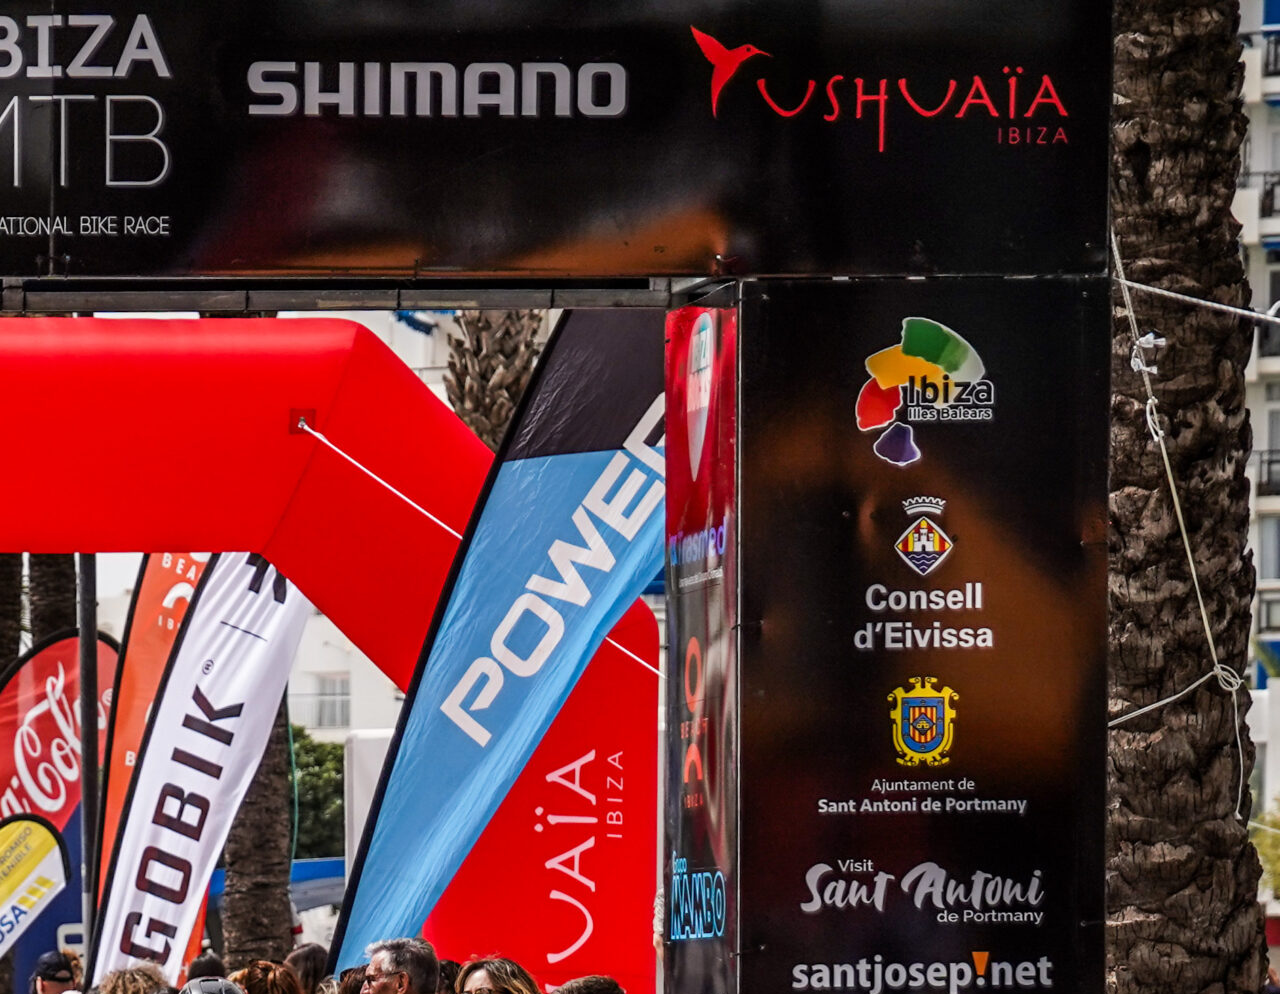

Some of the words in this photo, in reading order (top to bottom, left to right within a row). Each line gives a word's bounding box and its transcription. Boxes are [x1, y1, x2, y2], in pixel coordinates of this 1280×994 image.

[246, 61, 627, 117] SHIMANO
[755, 66, 1070, 154] USHUAÏA
[997, 126, 1069, 146] IBIZA
[79, 215, 118, 235] BIKE
[124, 215, 170, 235] RACE
[906, 375, 995, 406] Ibiza
[907, 406, 937, 420] Illes
[940, 406, 993, 420] Balears
[161, 553, 203, 580] BEA
[865, 582, 983, 611] Consell
[853, 620, 994, 650] d'Eivissa
[606, 751, 624, 839] IBIZA
[871, 777, 954, 795] Ajuntament
[958, 777, 975, 792] de
[818, 798, 857, 814] Sant
[860, 797, 917, 813] Antoni
[921, 797, 942, 813] de
[945, 797, 1028, 817] Portmany
[120, 683, 245, 966] GOBIK
[534, 749, 598, 966] UAÏA
[837, 858, 874, 873] Visit
[800, 862, 895, 914] Sant
[900, 860, 1045, 911] Antoni
[670, 871, 726, 940] MAMBO
[936, 909, 959, 924] de
[962, 909, 1045, 926] Portmany
